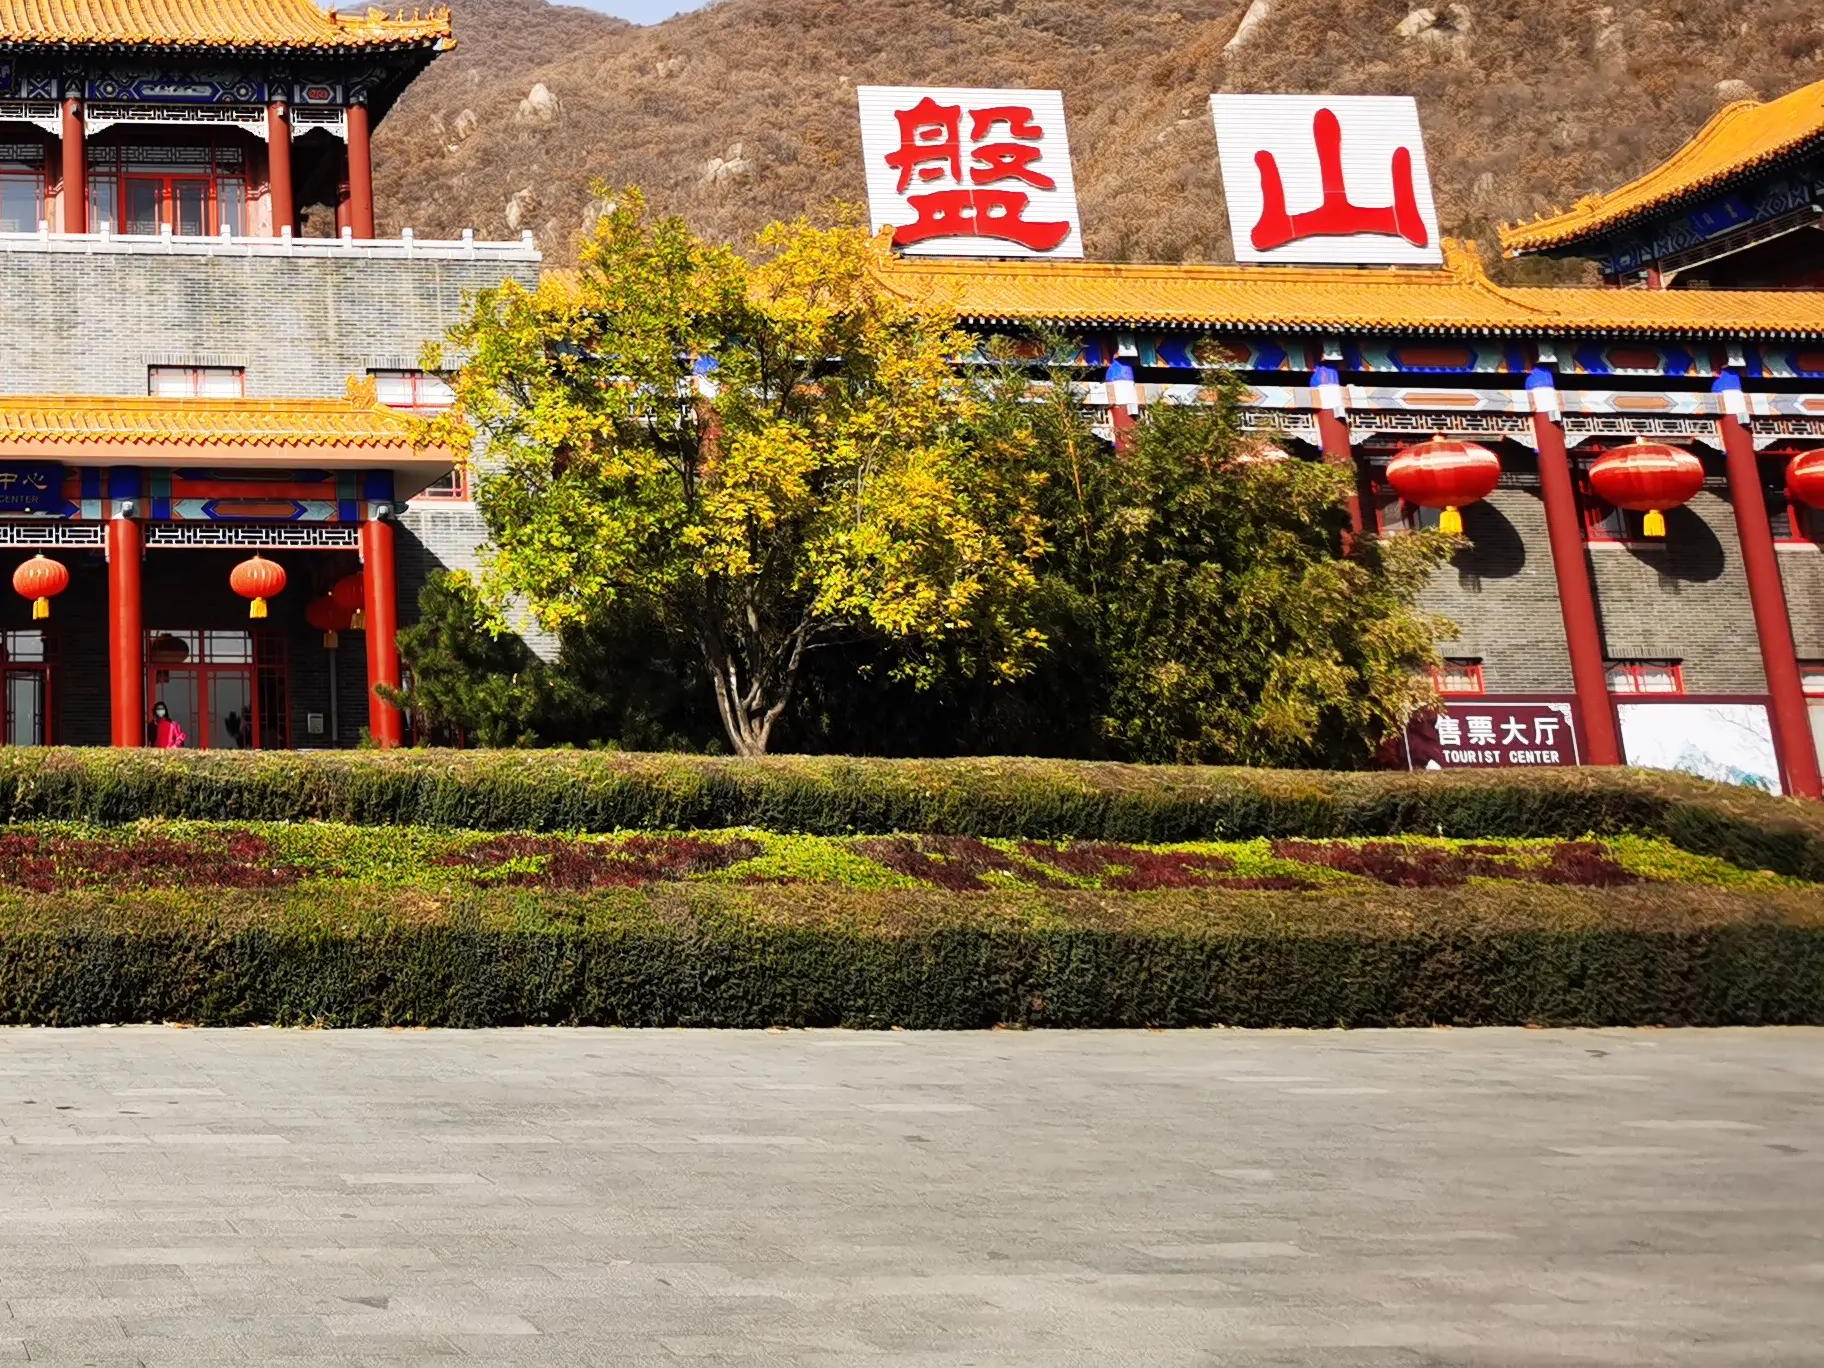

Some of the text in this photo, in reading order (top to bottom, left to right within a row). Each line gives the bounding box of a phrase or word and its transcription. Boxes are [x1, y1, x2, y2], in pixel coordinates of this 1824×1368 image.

[885, 97, 1428, 252] 盤 山
[1434, 715, 1560, 746] 售票大厅
[1442, 749, 1560, 764] TOURIST CENTER
